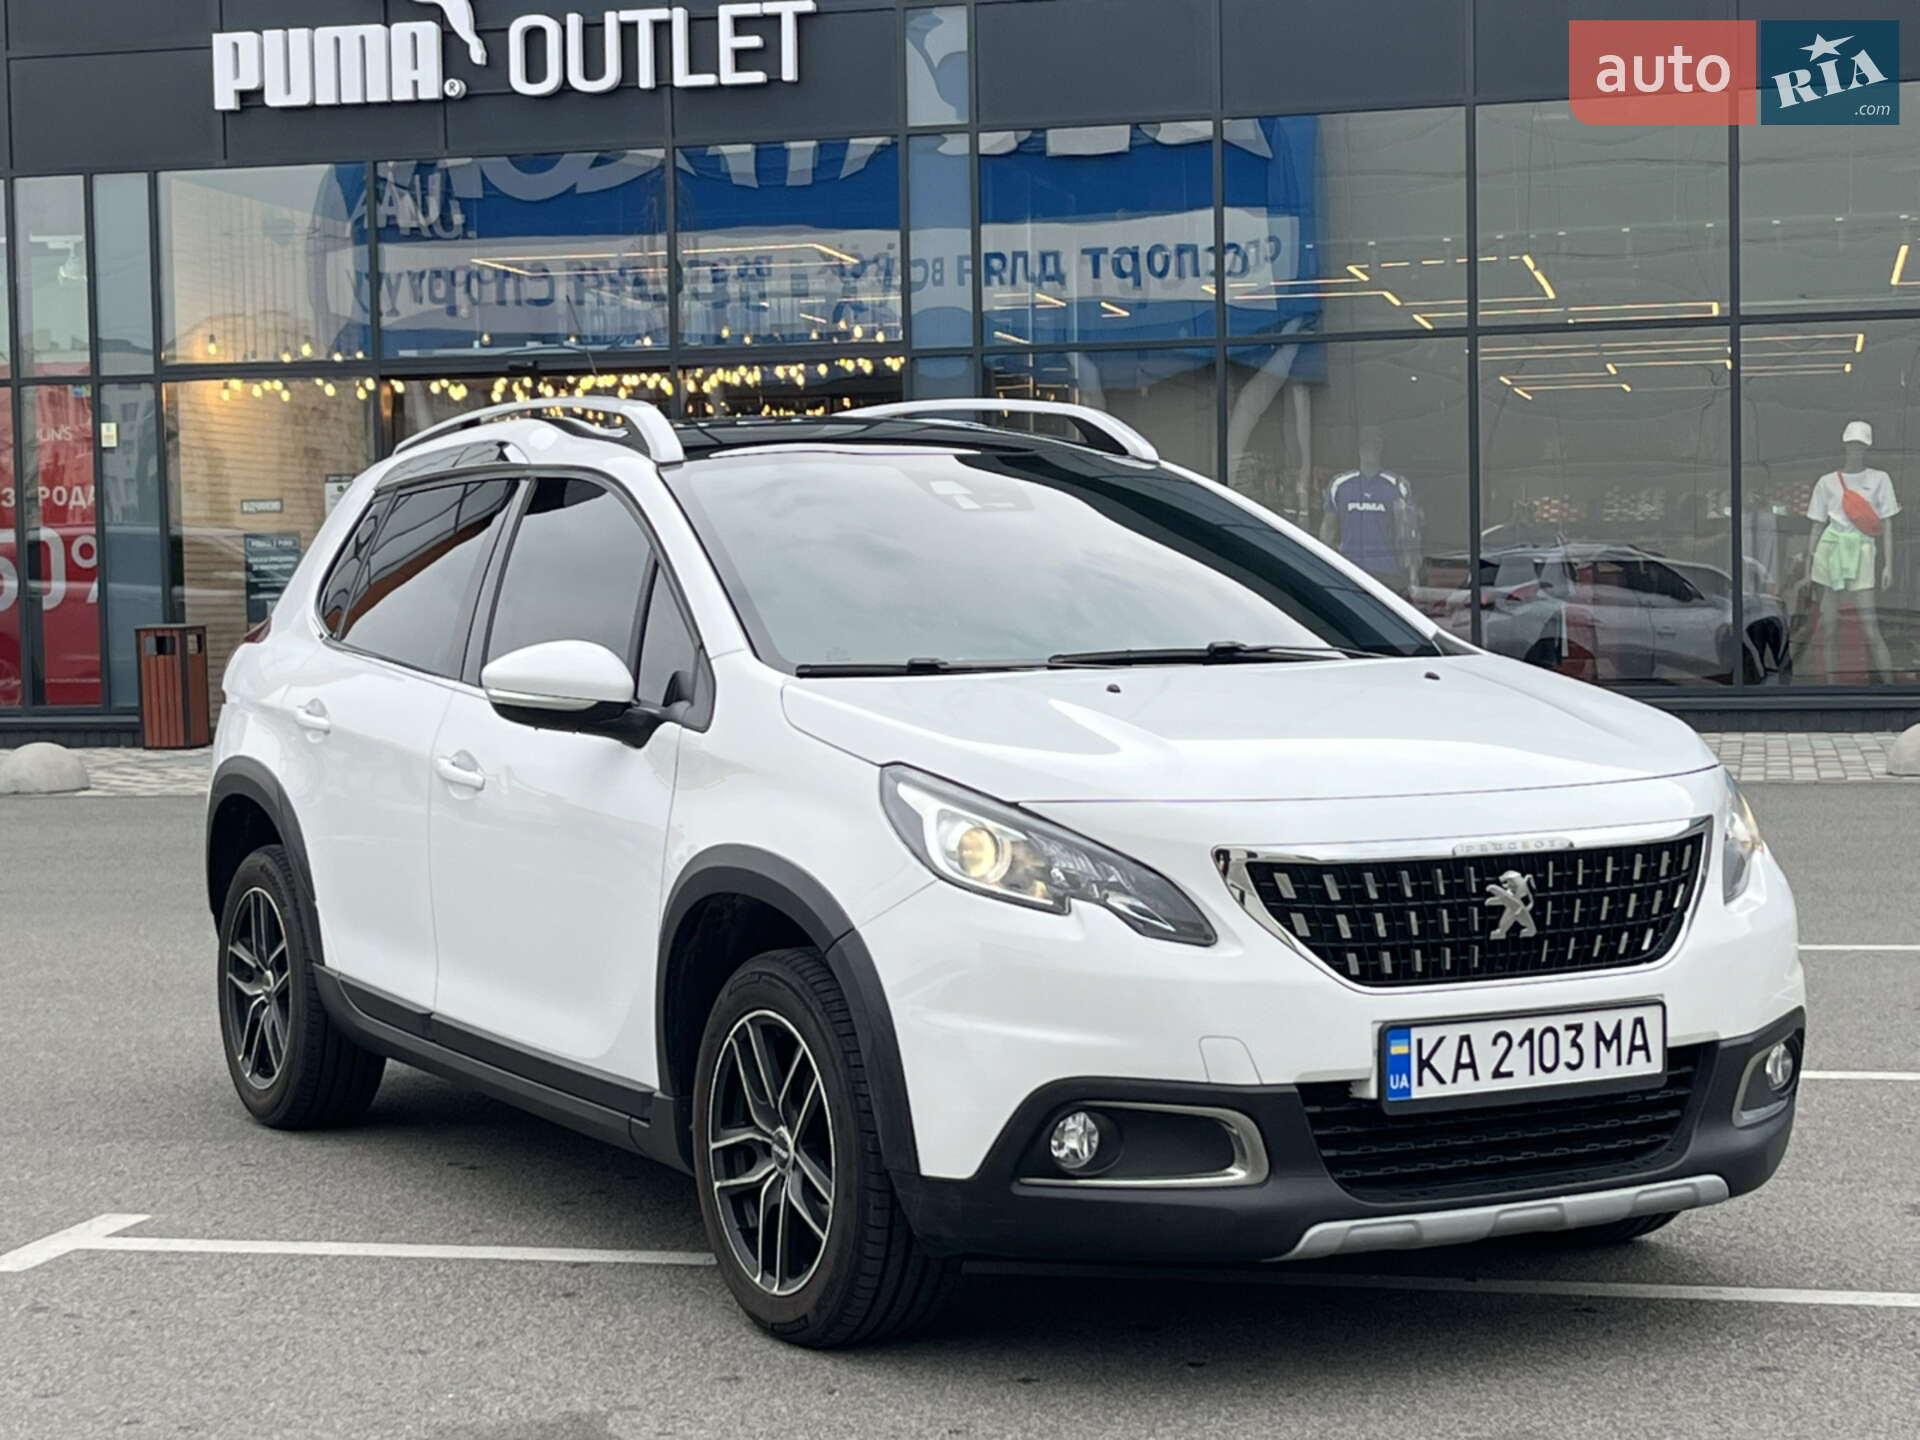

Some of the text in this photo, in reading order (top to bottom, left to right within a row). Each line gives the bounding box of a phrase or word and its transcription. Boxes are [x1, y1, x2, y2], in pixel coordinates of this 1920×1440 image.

[211, 20, 444, 111] PUMA
[507, 0, 817, 97] OUTLET
[1347, 502, 1386, 512] PUMA
[1416, 1016, 1652, 1087] KA 2103 MA
[1389, 1073, 1410, 1090] UA
